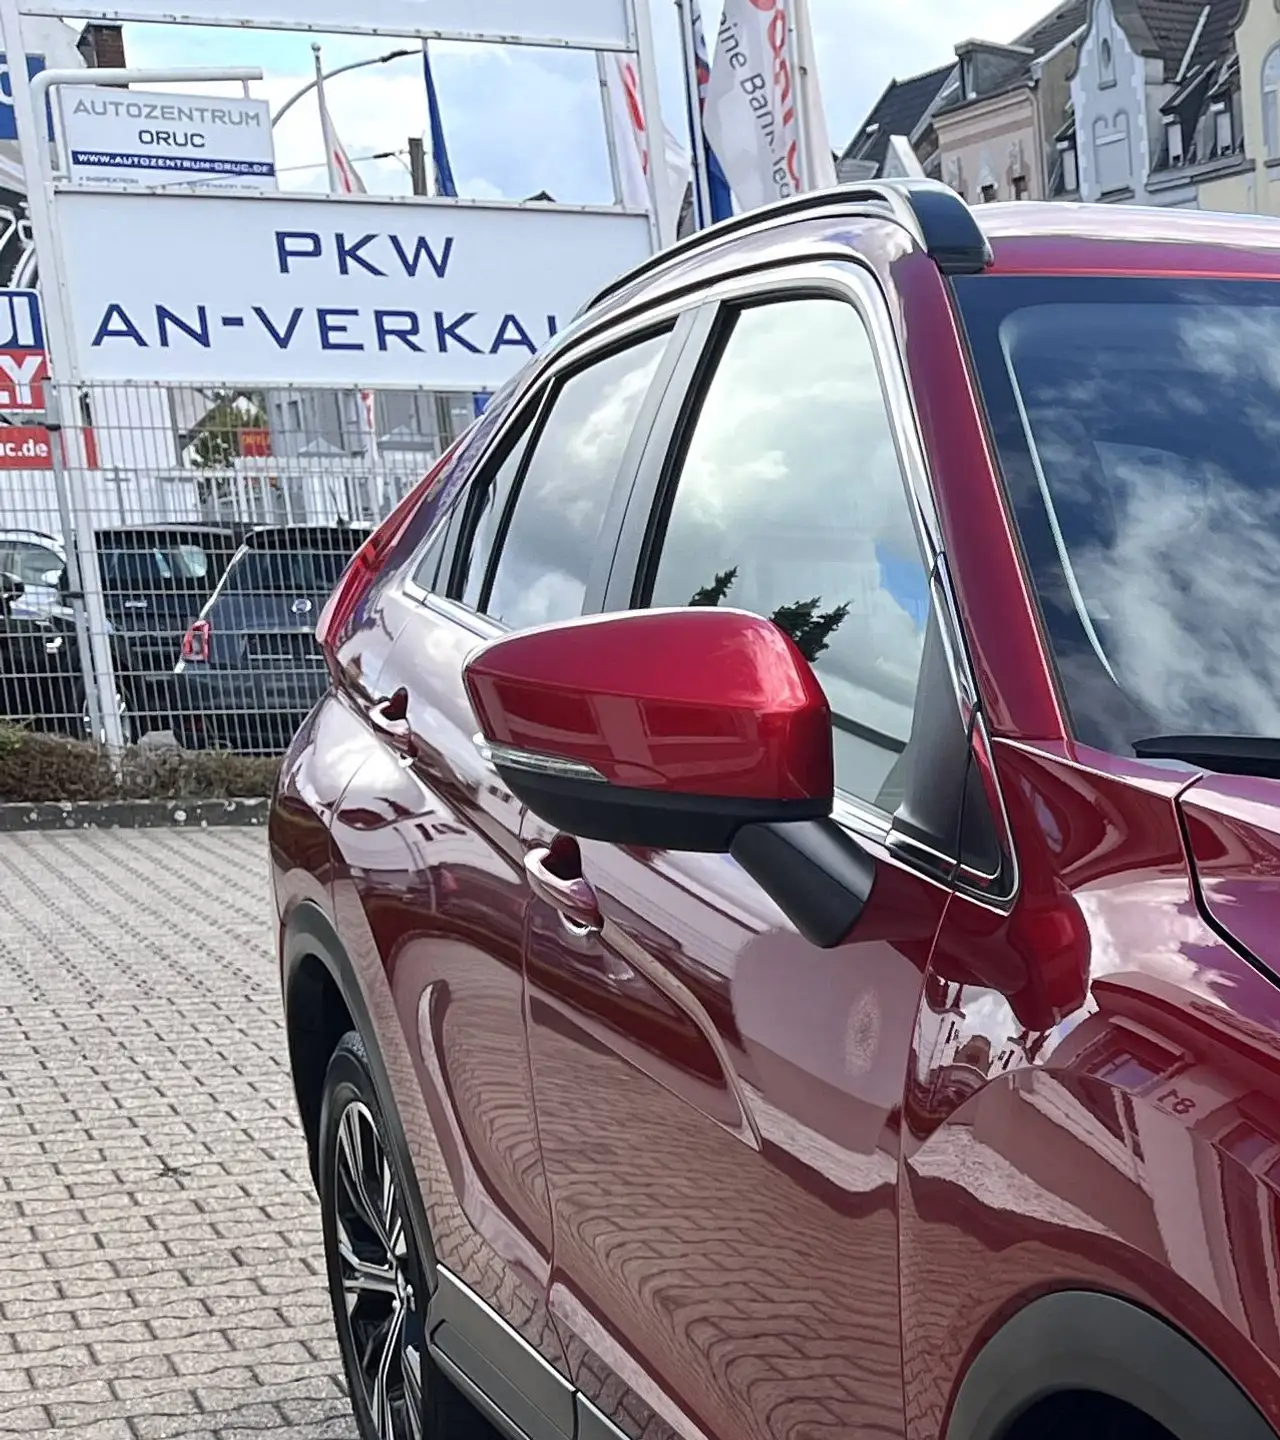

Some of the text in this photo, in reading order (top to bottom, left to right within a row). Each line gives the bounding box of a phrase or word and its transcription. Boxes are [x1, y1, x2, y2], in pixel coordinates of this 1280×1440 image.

[73, 99, 260, 127] AUTOZENTRUM
[138, 130, 205, 148] ORUC
[275, 230, 454, 278] PKW
